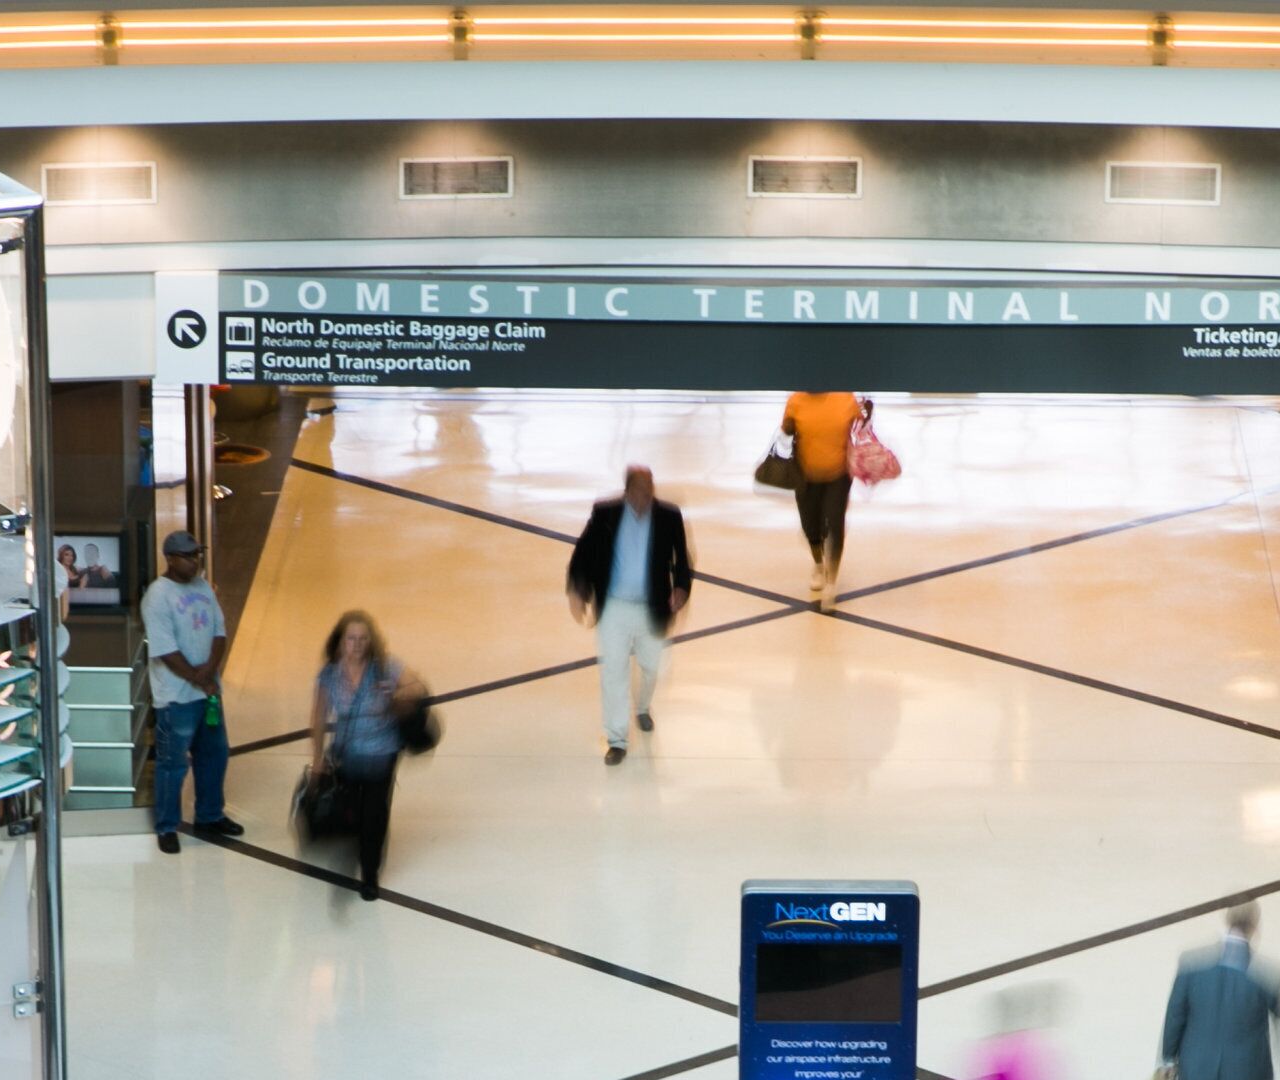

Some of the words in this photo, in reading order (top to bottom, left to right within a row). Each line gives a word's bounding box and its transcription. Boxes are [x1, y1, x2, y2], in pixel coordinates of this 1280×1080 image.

[243, 279, 630, 317] DOMESTIC
[693, 287, 1081, 321] TERMINAL
[261, 317, 315, 335] North
[320, 319, 405, 336] Domestic
[409, 320, 491, 341] Baggage
[494, 322, 547, 339] Claim
[262, 336, 312, 348] Reclamo
[314, 338, 330, 349] de
[331, 338, 383, 351] Equipaje
[385, 339, 436, 350] Terminal
[438, 341, 490, 351] Nacional
[491, 341, 526, 352] Norte
[1183, 346, 1222, 358] Ventas
[1224, 346, 1240, 358] de
[262, 352, 331, 369] Ground
[335, 354, 472, 374] Transportation
[262, 370, 324, 383] Transporte
[326, 372, 379, 383] Terrestre
[775, 902, 886, 922] NextGEN
[762, 931, 784, 940] You
[785, 931, 832, 940] Deserve
[834, 932, 848, 940] an
[850, 931, 898, 942] Upgrade
[771, 1039, 813, 1049] Discover
[815, 1040, 837, 1049] how
[838, 1041, 888, 1051] upgrading
[766, 1055, 783, 1063] our
[784, 1055, 826, 1064] airspace
[827, 1055, 891, 1064] infrastructure
[794, 1070, 840, 1079] improves
[841, 1070, 863, 1080] your
